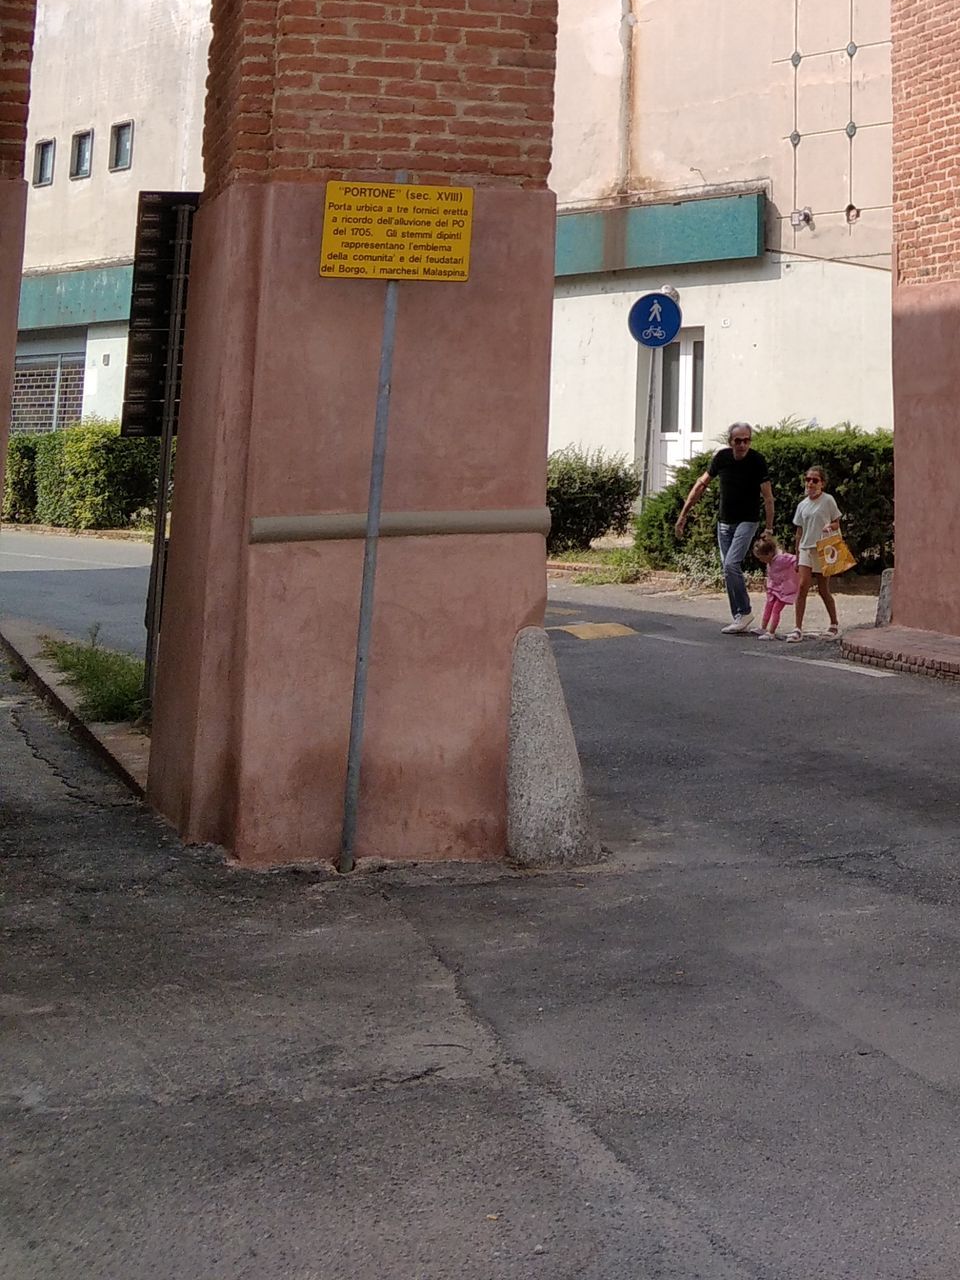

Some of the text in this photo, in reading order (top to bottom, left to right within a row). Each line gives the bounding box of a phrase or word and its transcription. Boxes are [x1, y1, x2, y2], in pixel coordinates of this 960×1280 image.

[406, 189, 432, 200] (sec.
[437, 191, 463, 202] XVIII)
[328, 202, 352, 210] Porta
[356, 204, 383, 212] urbica
[413, 206, 439, 215] fornici
[443, 208, 468, 216] eretta
[342, 216, 373, 224] ricordo
[435, 219, 448, 227] del
[452, 220, 465, 228] PO
[333, 228, 462, 240] del 1705. Gli stemmi dipinti
[341, 241, 405, 250] rappresentano
[327, 252, 348, 260] della
[409, 255, 422, 263] dei
[426, 255, 464, 264] feudatari
[321, 264, 334, 272] del
[380, 267, 419, 275] marchesi
